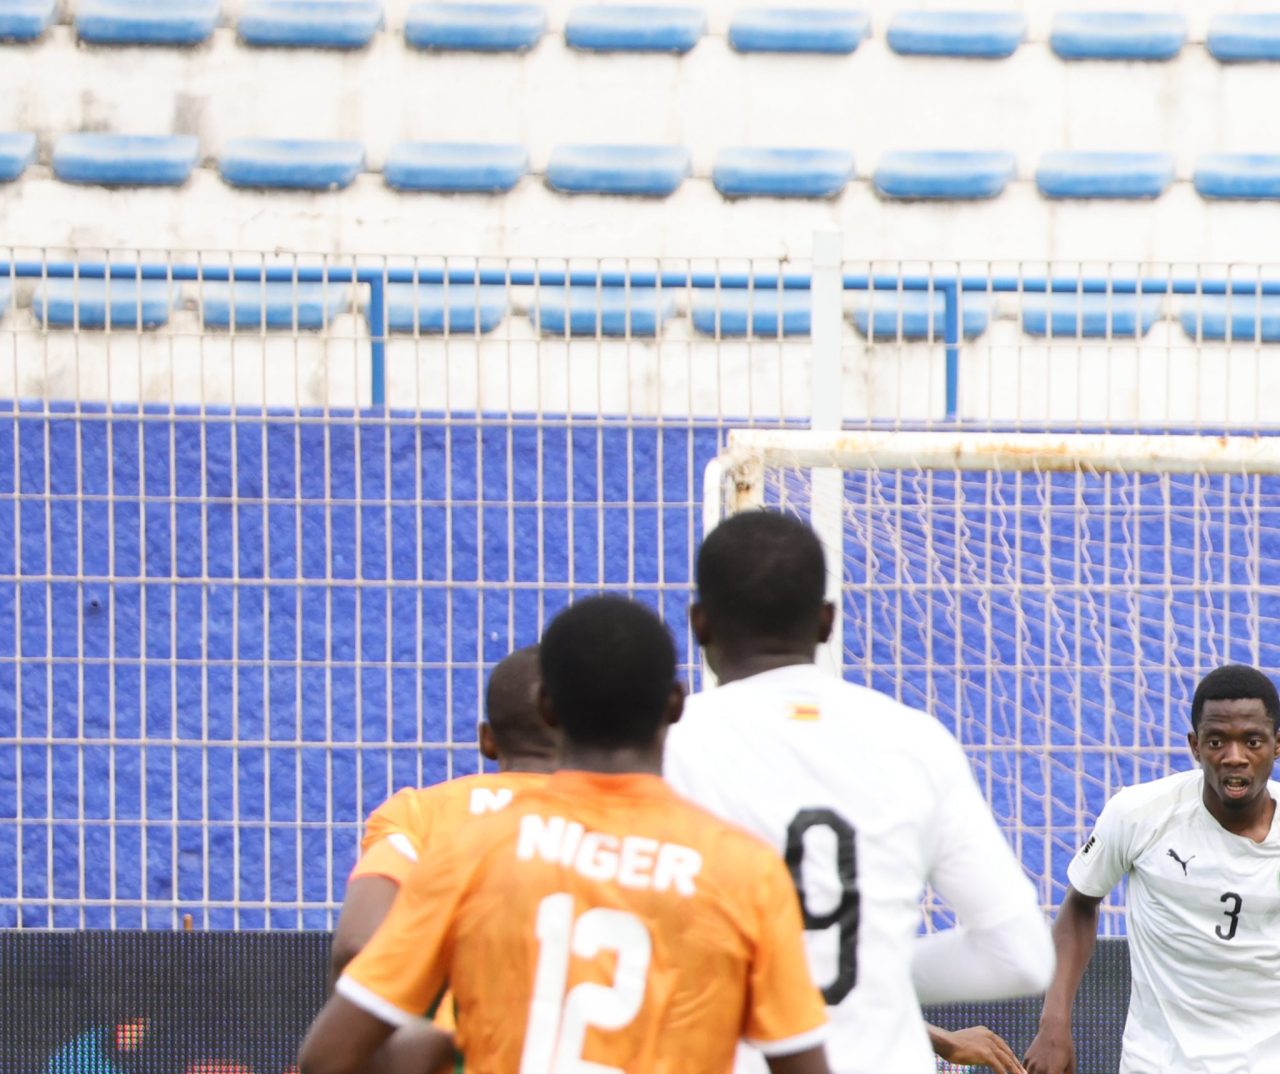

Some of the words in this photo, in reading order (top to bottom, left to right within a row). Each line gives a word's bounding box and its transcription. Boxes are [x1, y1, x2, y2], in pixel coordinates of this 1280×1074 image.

[516, 813, 703, 897] NIGER
[784, 808, 861, 1006] 9
[1214, 891, 1243, 941] 3
